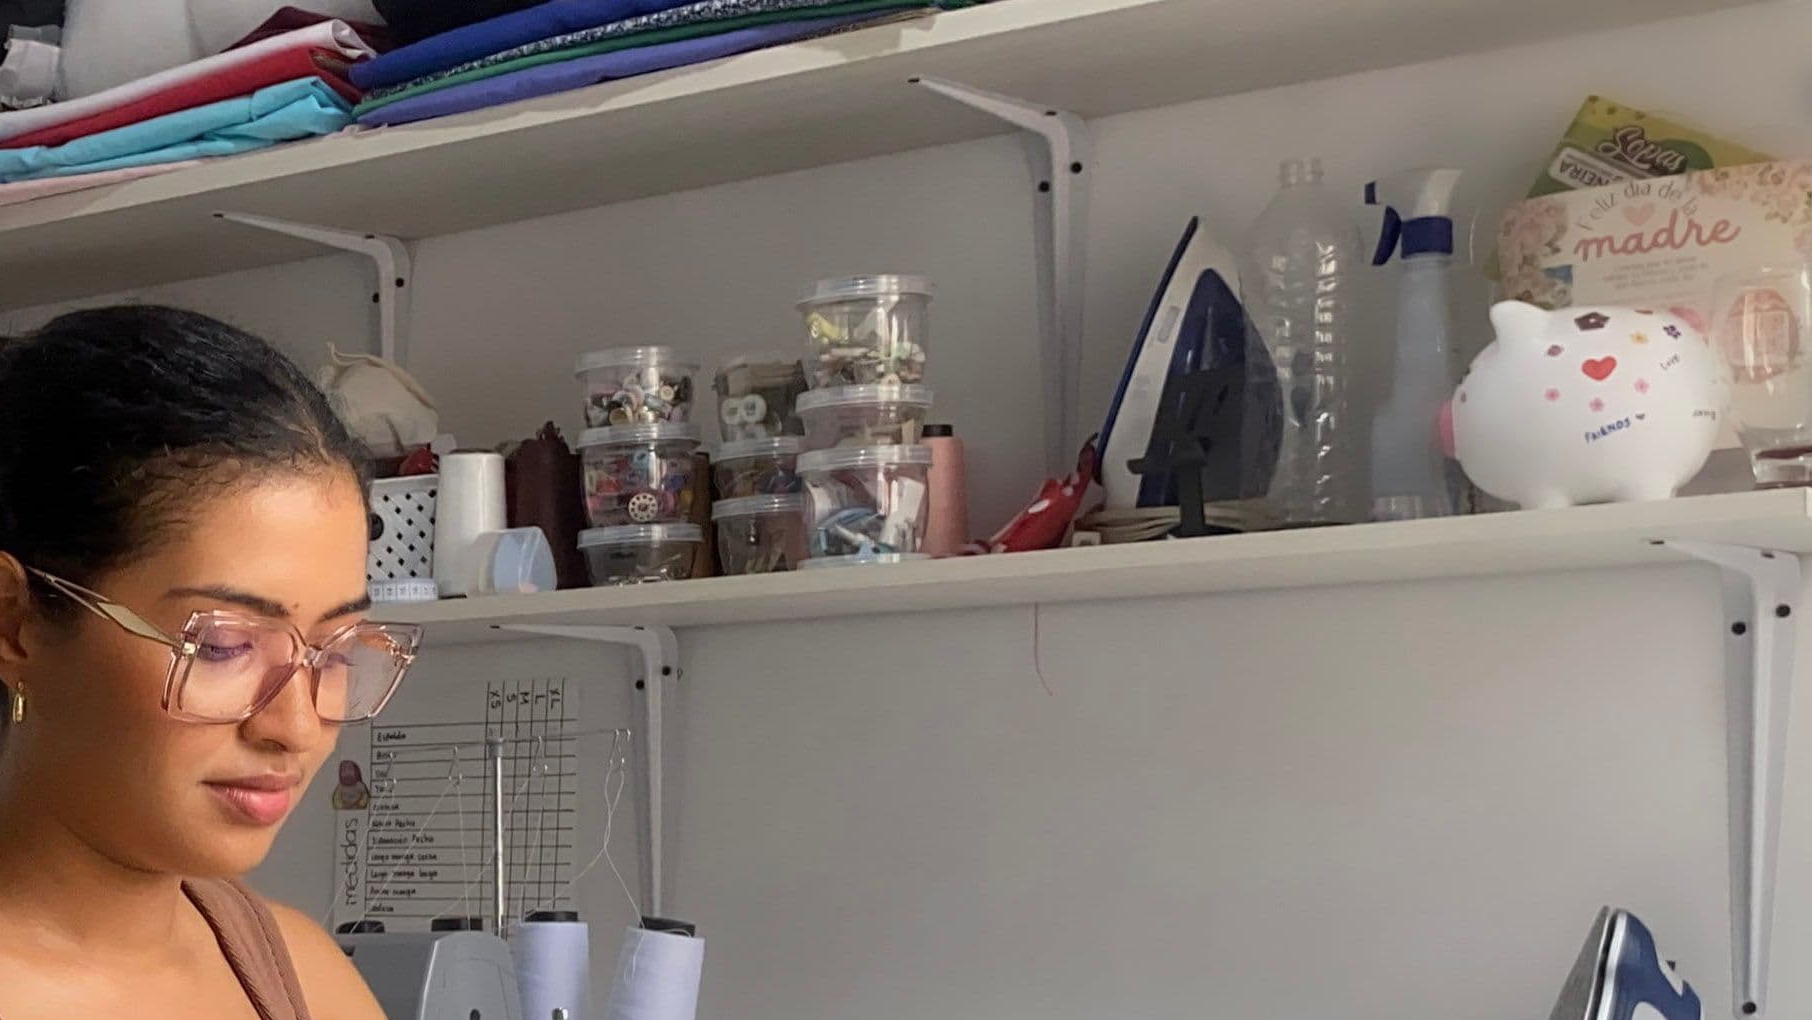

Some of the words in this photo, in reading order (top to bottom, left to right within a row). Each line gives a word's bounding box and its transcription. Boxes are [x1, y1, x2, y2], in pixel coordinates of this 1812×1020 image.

[1574, 209, 1742, 262] madre
[1583, 416, 1631, 444] FRIENDS
[490, 689, 501, 710] XS
[506, 692, 517, 703] S
[519, 691, 530, 705] M
[534, 694, 546, 704] L
[549, 687, 561, 710] XL
[339, 818, 359, 907] medidas
